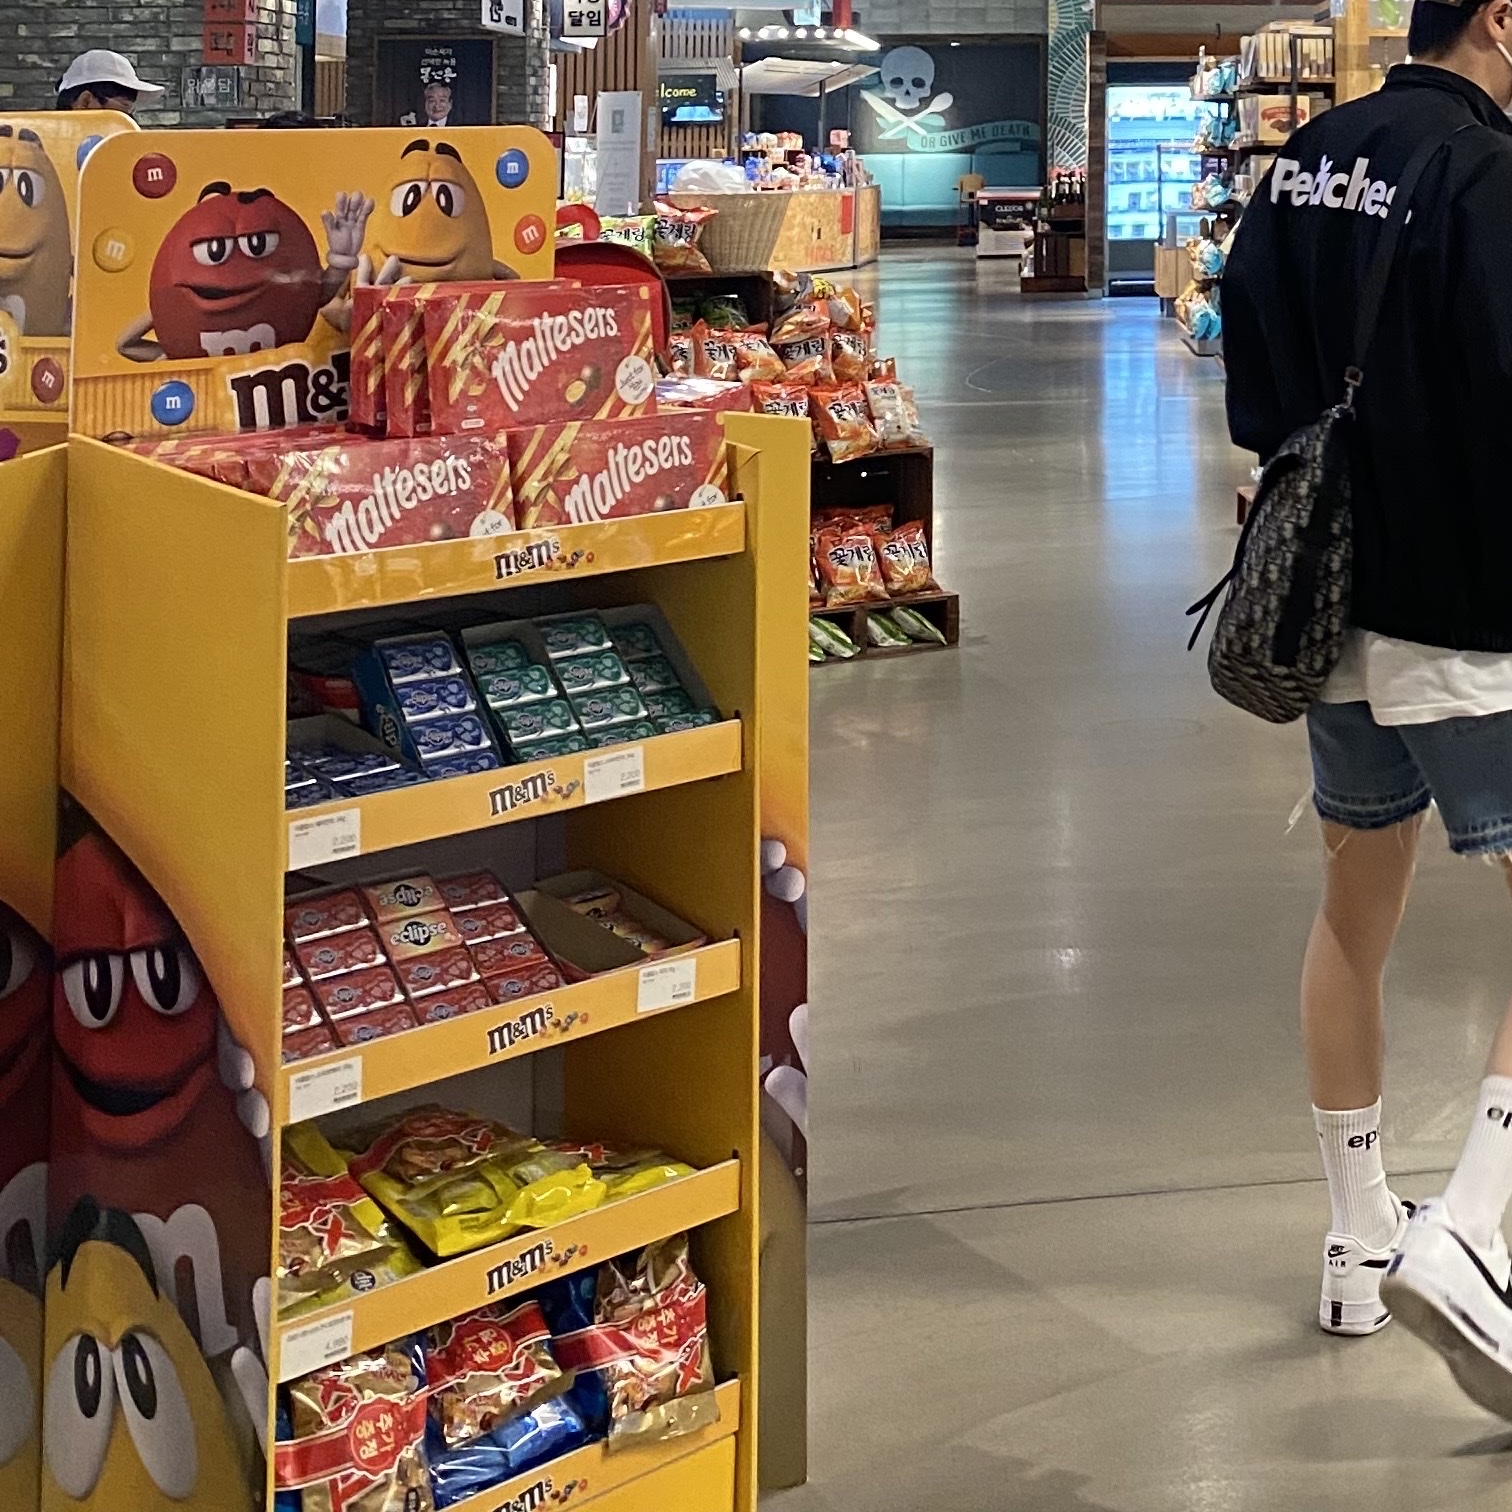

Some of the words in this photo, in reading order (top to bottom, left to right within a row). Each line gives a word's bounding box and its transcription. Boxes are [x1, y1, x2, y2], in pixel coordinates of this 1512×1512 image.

[939, 131, 966, 148] GIVE
[970, 125, 988, 140] ME
[992, 123, 1031, 138] DEATH
[491, 306, 618, 412] Maltesers
[325, 457, 472, 555] Maltesers
[564, 434, 692, 525] Maltesers
[390, 921, 447, 948] eclipse
